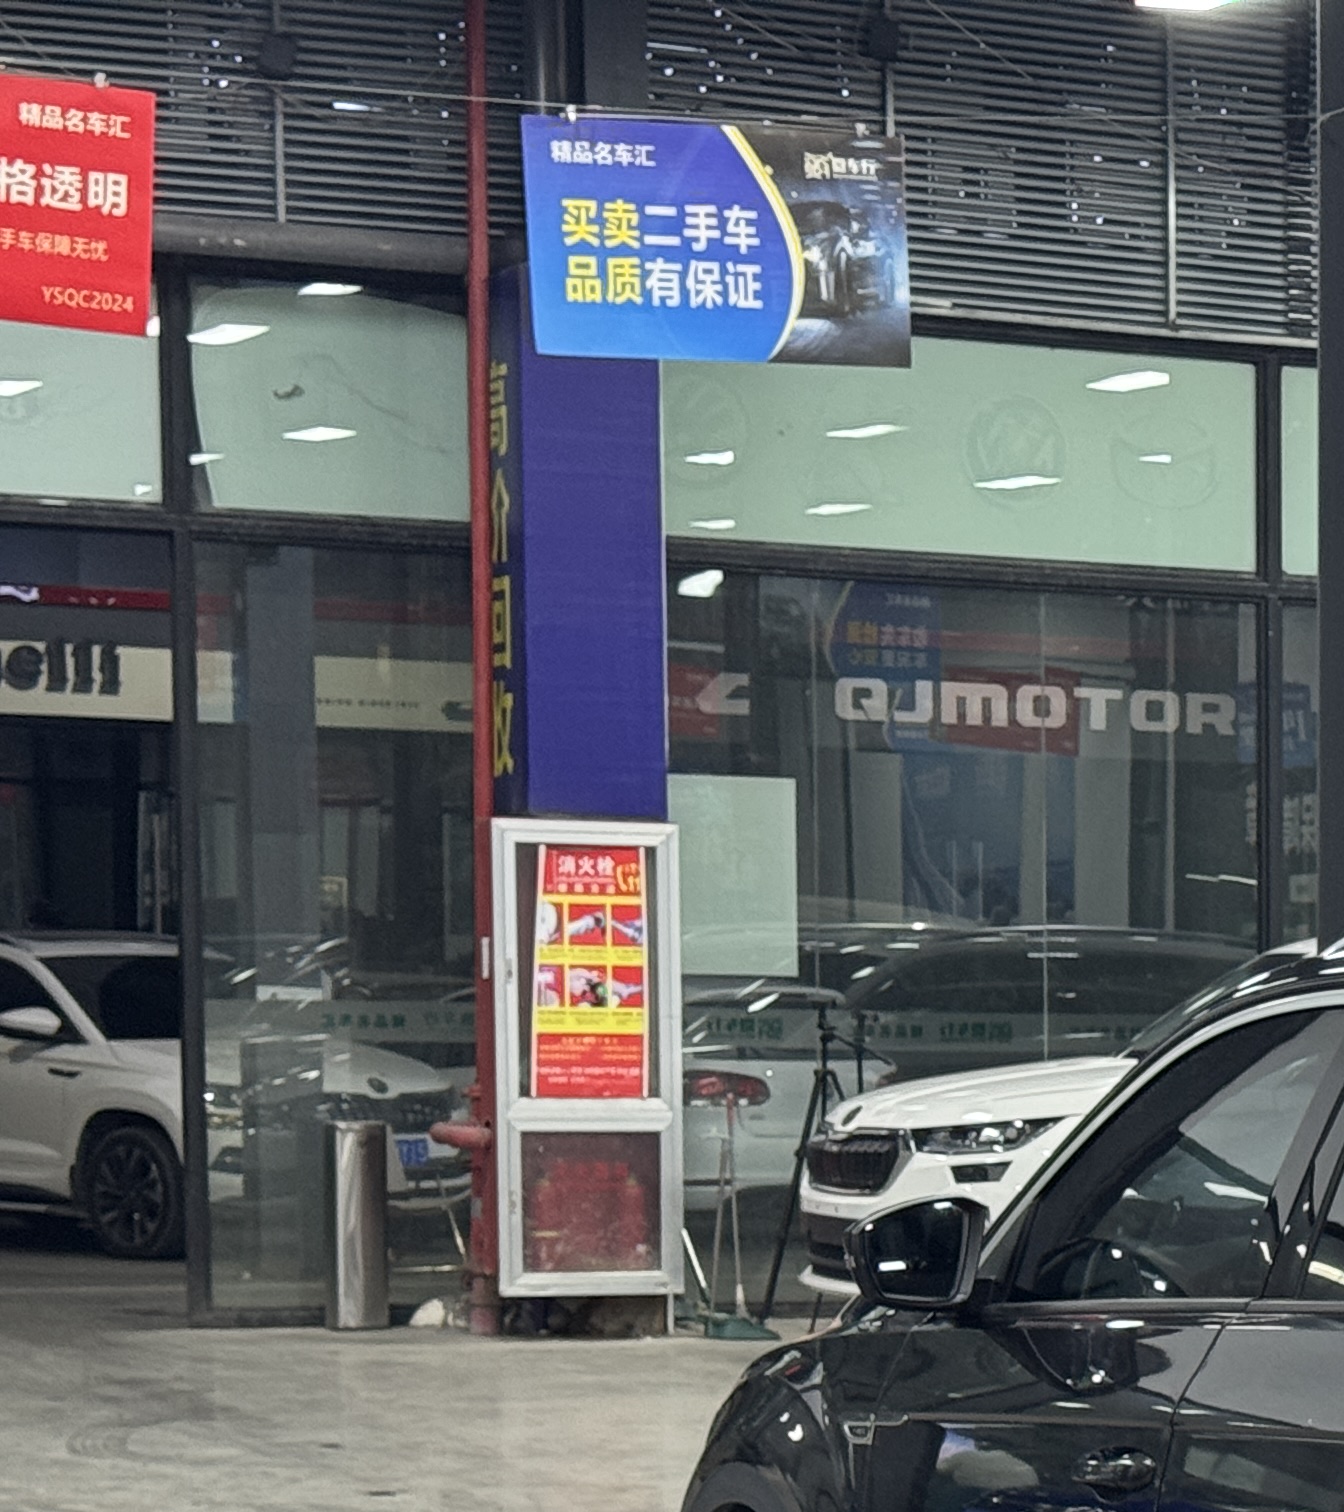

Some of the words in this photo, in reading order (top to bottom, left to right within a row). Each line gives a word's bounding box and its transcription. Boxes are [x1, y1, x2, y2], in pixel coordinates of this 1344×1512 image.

[19, 101, 131, 139] 精品名车汇
[550, 140, 656, 168] 精品名车汇
[561, 198, 761, 255] 买卖二手车
[41, 285, 134, 313] YSQC2024
[564, 256, 764, 310] 品质有保证
[834, 676, 1238, 736] QJMOTOR
[558, 855, 616, 876] 消火栓
